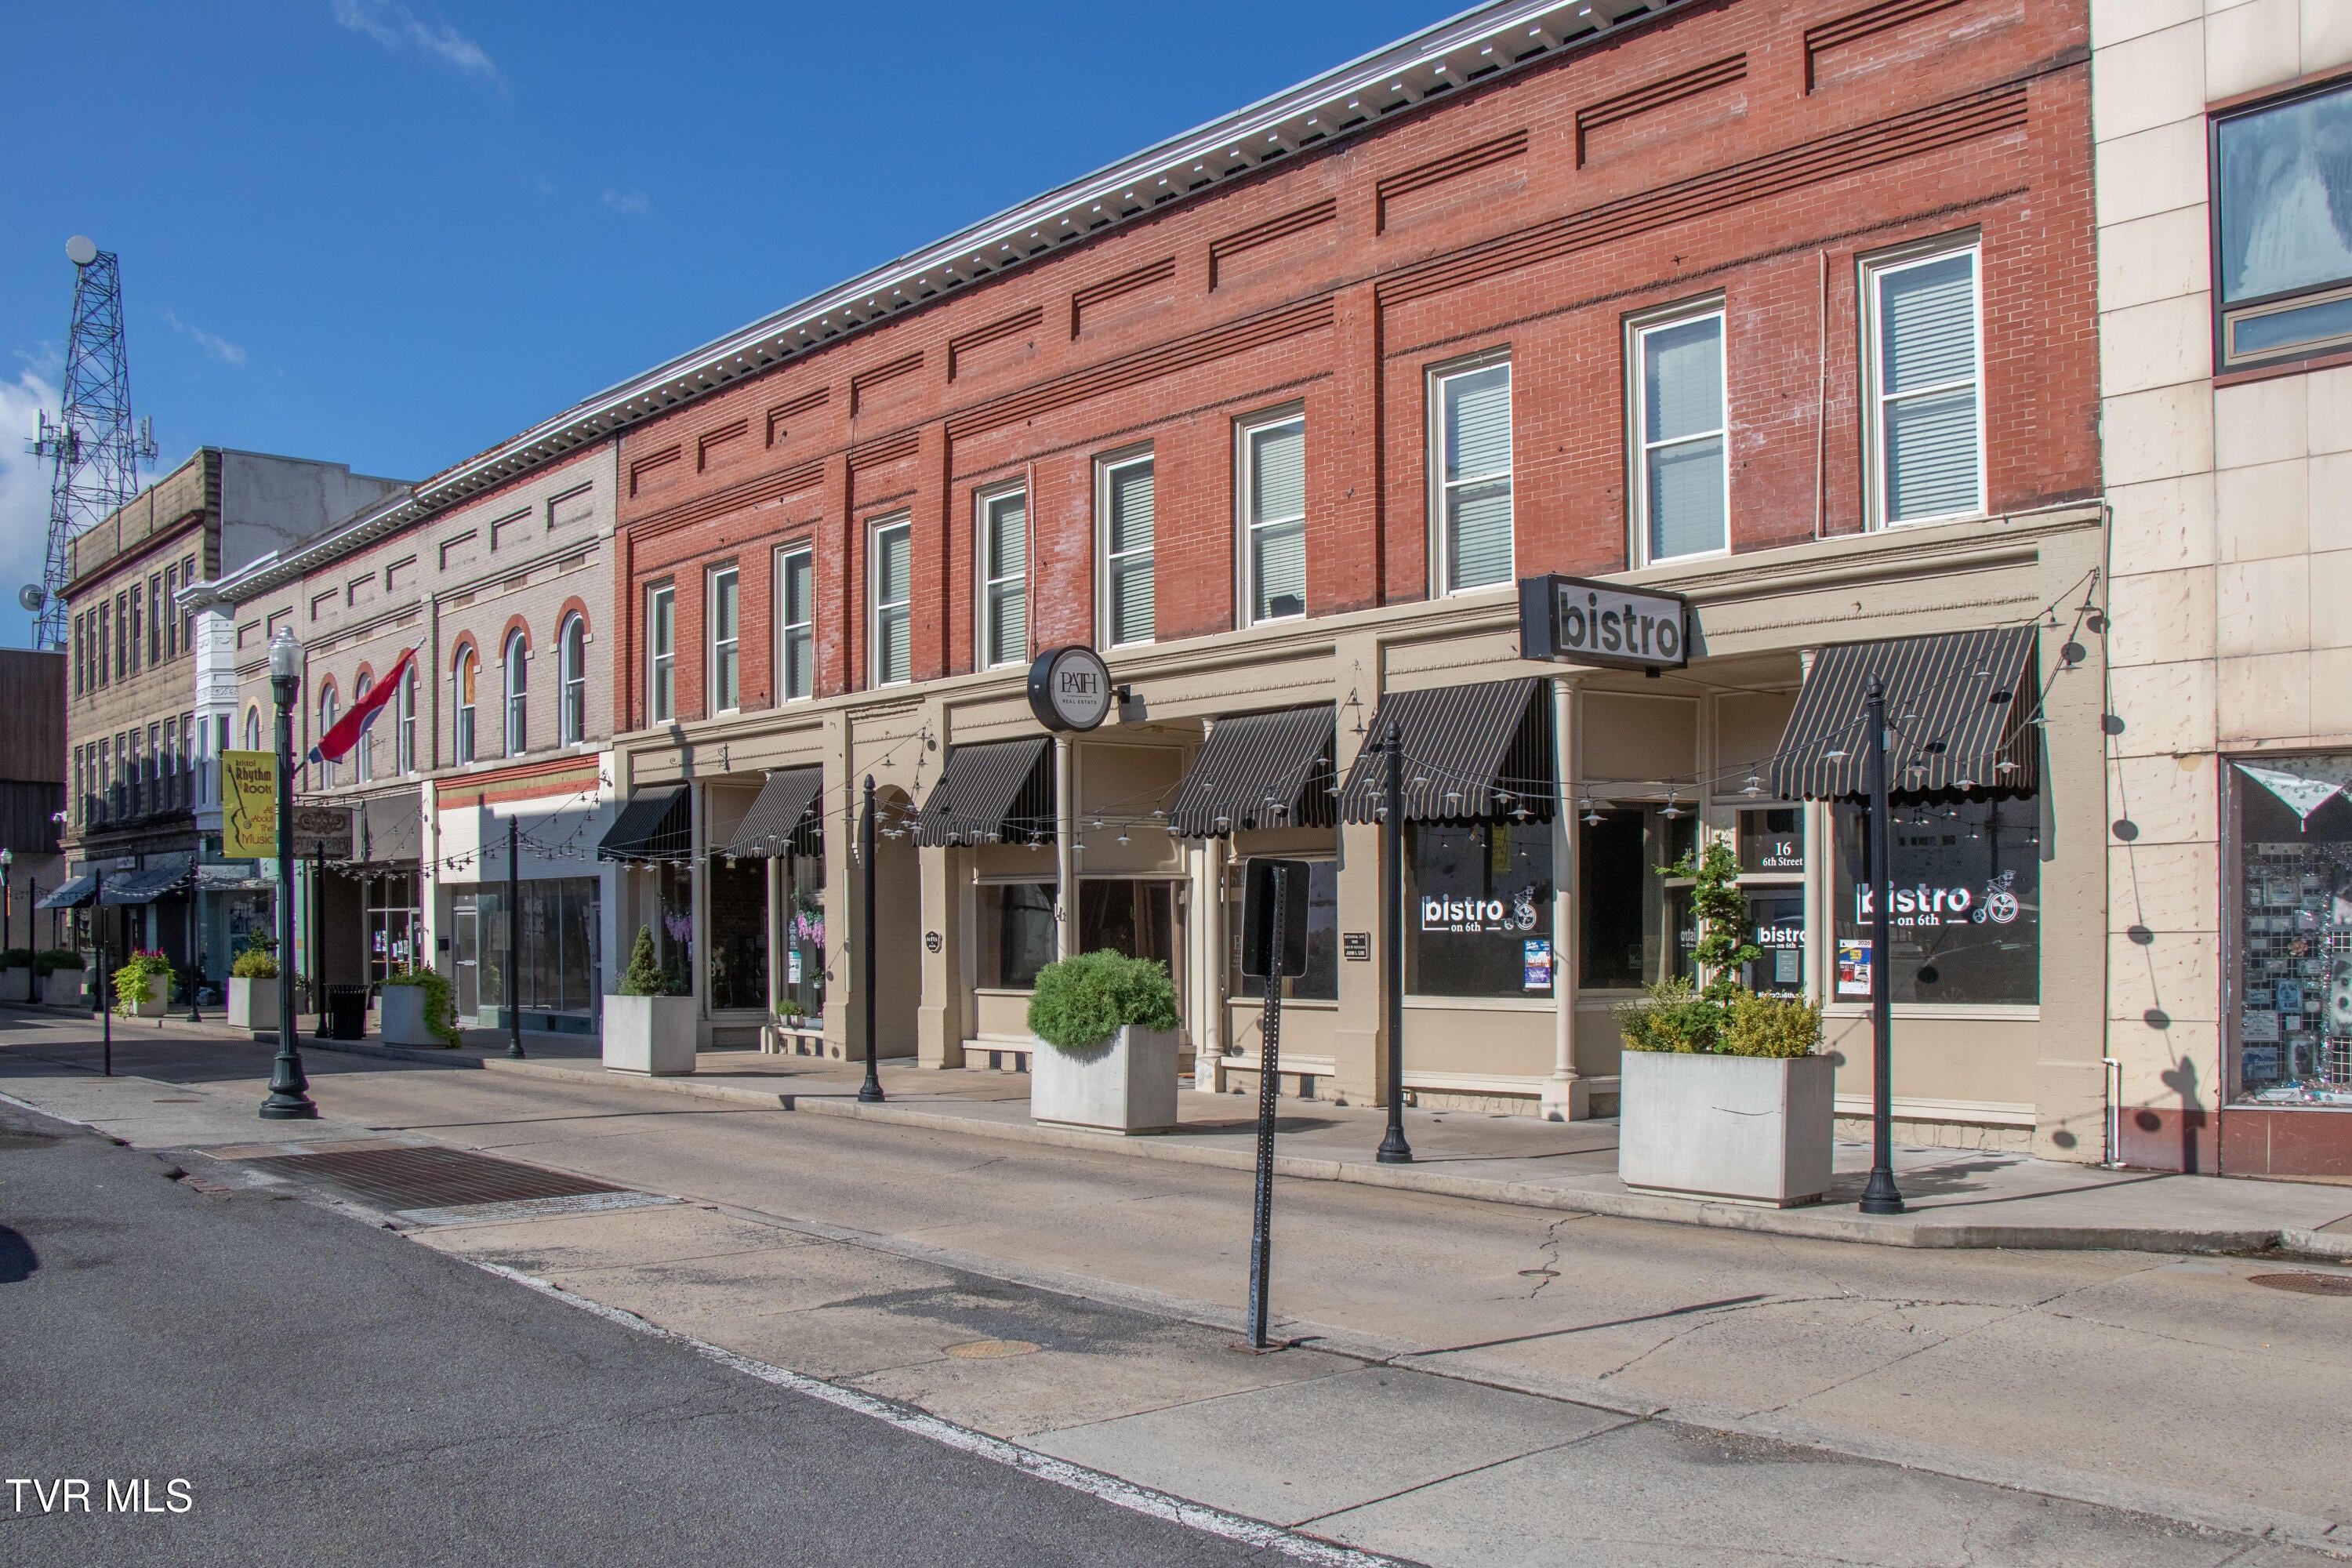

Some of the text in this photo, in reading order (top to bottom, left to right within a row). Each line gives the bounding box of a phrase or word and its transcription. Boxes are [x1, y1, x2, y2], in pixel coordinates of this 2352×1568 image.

[1559, 591, 1679, 658] bistro
[1061, 672, 1098, 694] PATH
[236, 768, 272, 782] Rhythm
[244, 783, 272, 794] Roots
[241, 833, 274, 844] Music
[1776, 841, 1792, 856] 16
[1762, 857, 1803, 866] 6th Street
[1425, 894, 1504, 921] bistro
[1897, 913, 1940, 926] on 6th
[1465, 921, 1481, 932] 6th
